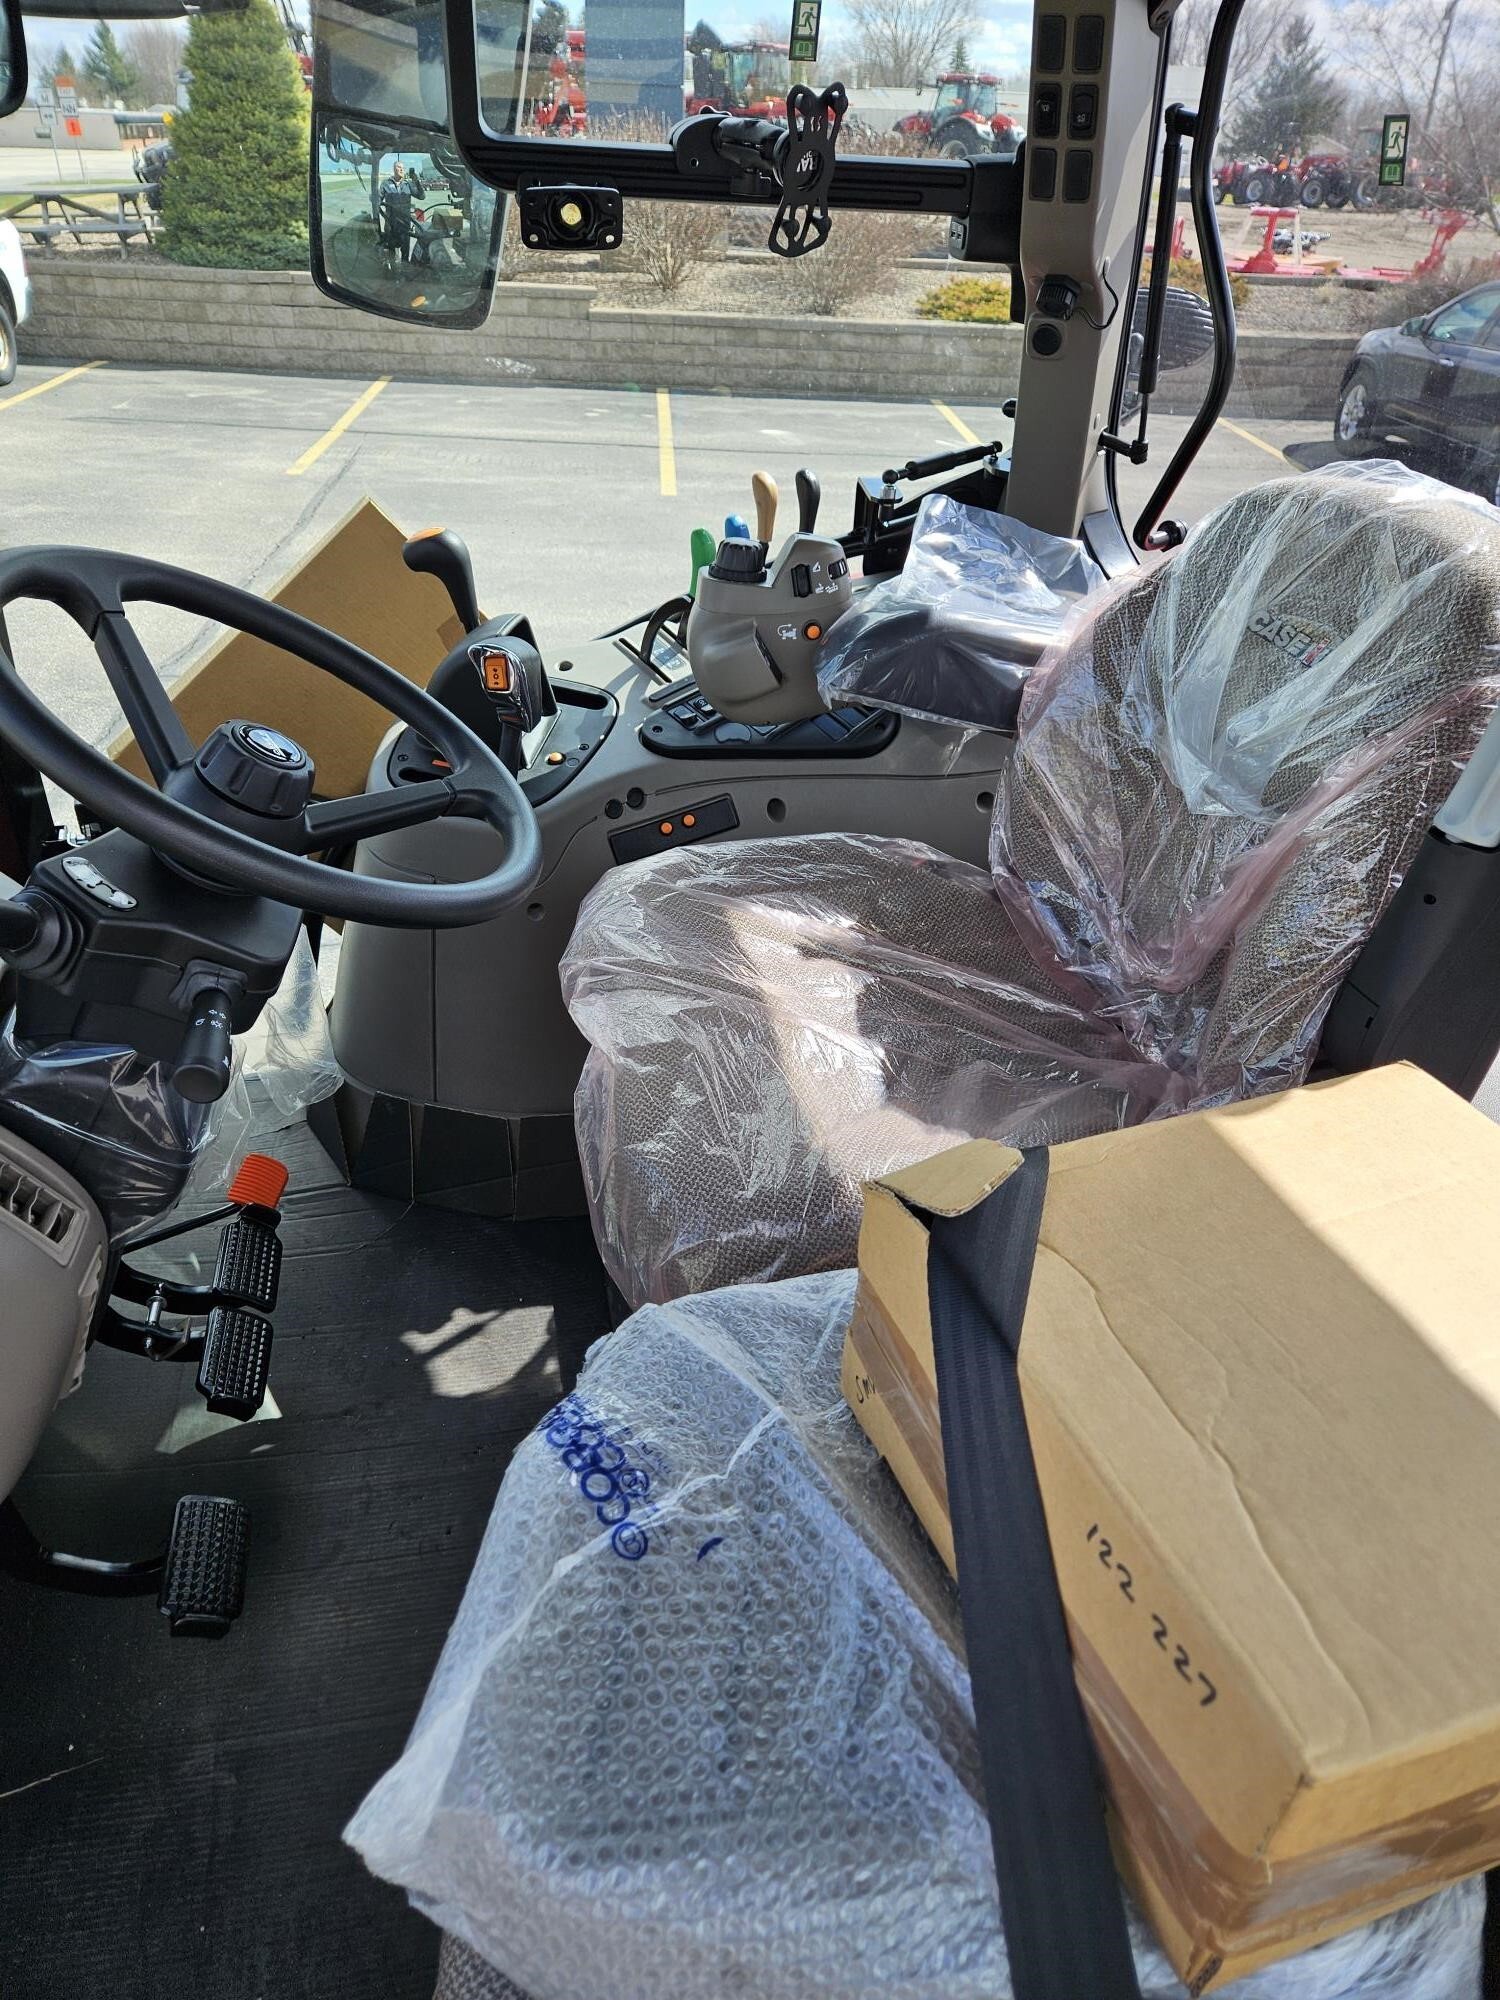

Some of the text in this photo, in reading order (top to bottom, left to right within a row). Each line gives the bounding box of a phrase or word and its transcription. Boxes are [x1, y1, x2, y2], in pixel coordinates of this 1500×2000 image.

[1247, 608, 1312, 658] CASE
[1086, 1523, 1217, 1707] 122 227
